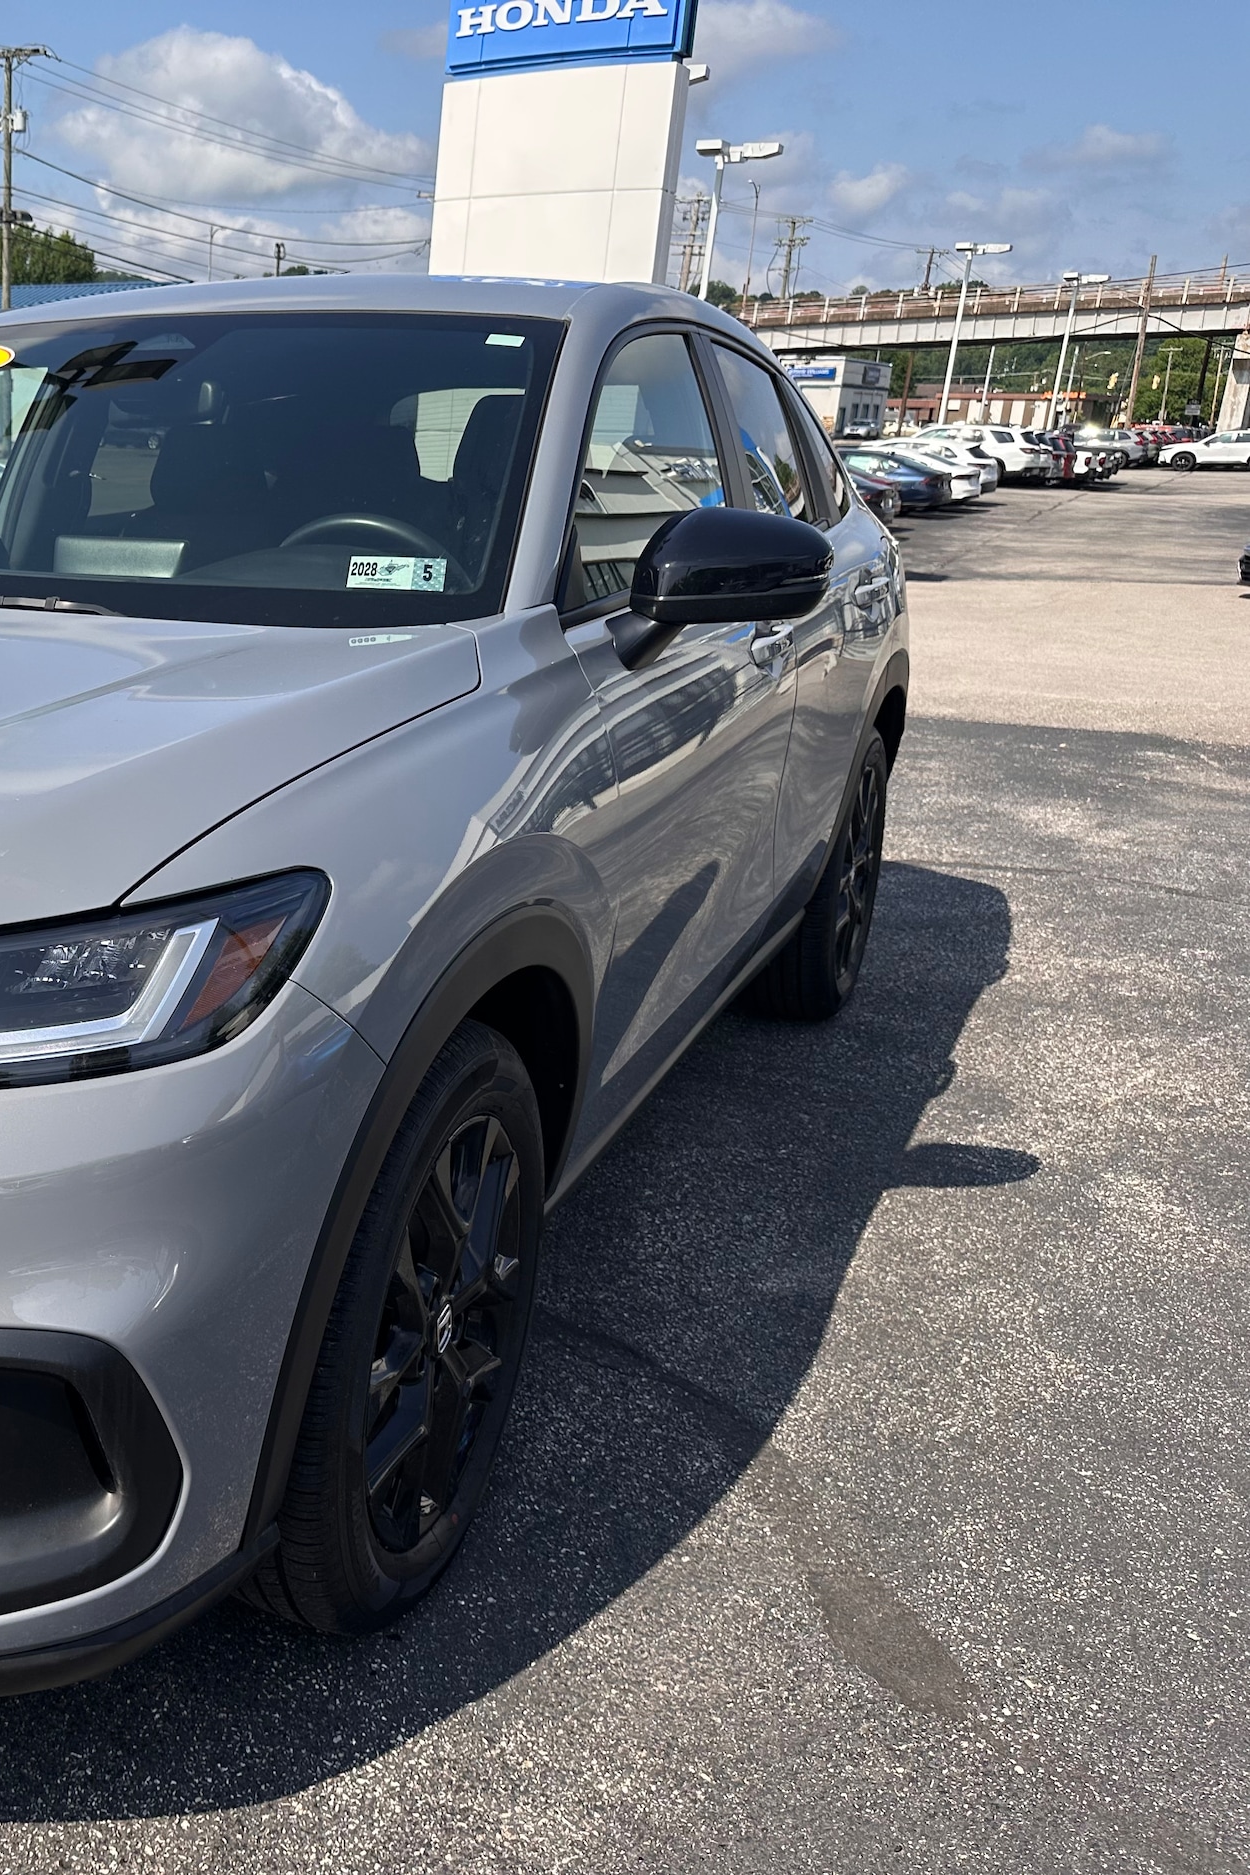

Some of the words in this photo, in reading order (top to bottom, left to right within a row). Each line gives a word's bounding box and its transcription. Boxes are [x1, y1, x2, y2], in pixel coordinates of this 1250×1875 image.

[455, 0, 668, 38] HONDA
[351, 562, 378, 576] 2028
[422, 564, 433, 582] 5
